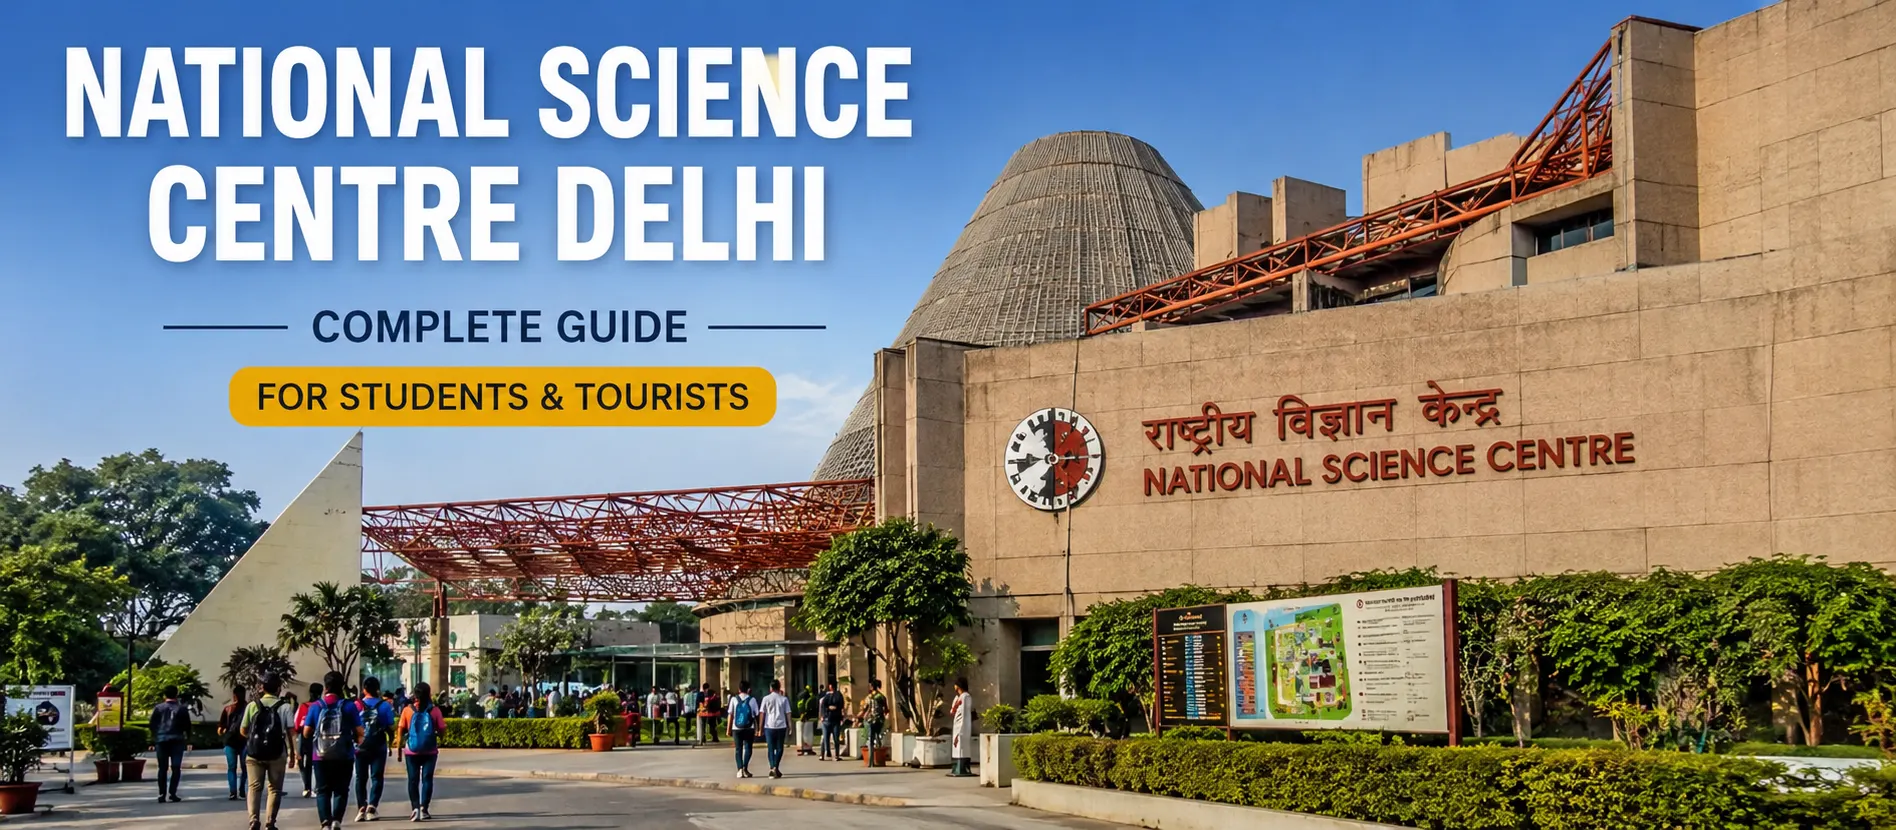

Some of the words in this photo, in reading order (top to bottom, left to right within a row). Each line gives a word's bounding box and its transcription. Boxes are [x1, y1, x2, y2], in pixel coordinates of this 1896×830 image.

[1142, 401, 1256, 456] राष्ट्रीय
[1274, 394, 1397, 443] विज्ञान
[1418, 380, 1504, 428] केन्द्र
[1143, 455, 1311, 497] NATIONAL
[1321, 444, 1475, 485] SCIENCE
[1486, 431, 1636, 474] CENTRE
